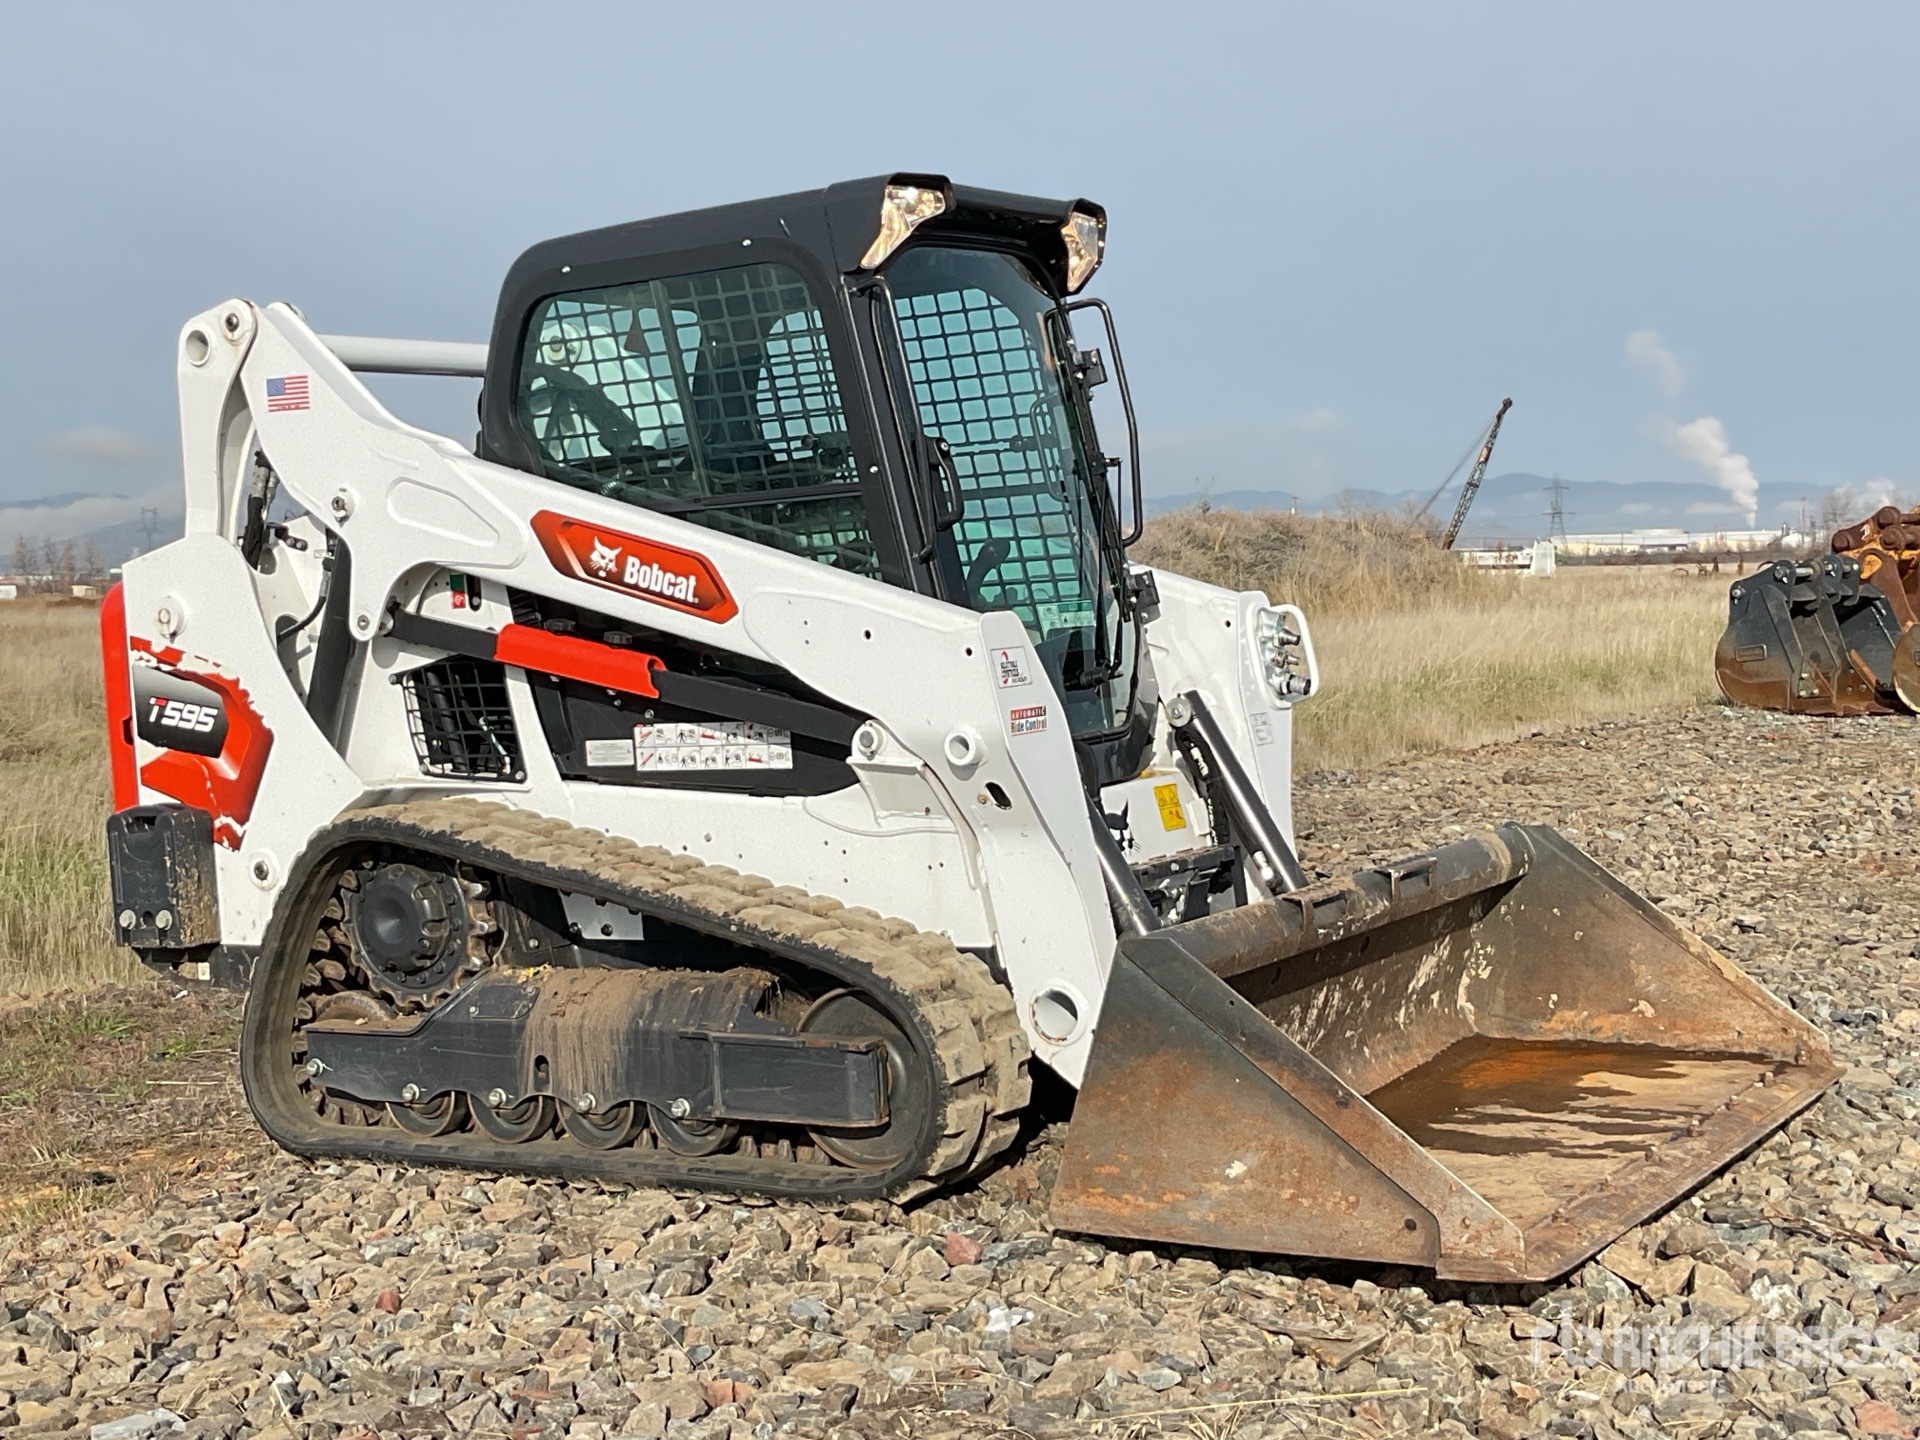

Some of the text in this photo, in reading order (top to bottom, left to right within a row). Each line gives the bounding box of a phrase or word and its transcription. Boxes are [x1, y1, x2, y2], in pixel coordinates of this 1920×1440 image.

[623, 555, 697, 603] Bobcat
[149, 697, 218, 732] T595
[1025, 717, 1047, 731] Control
